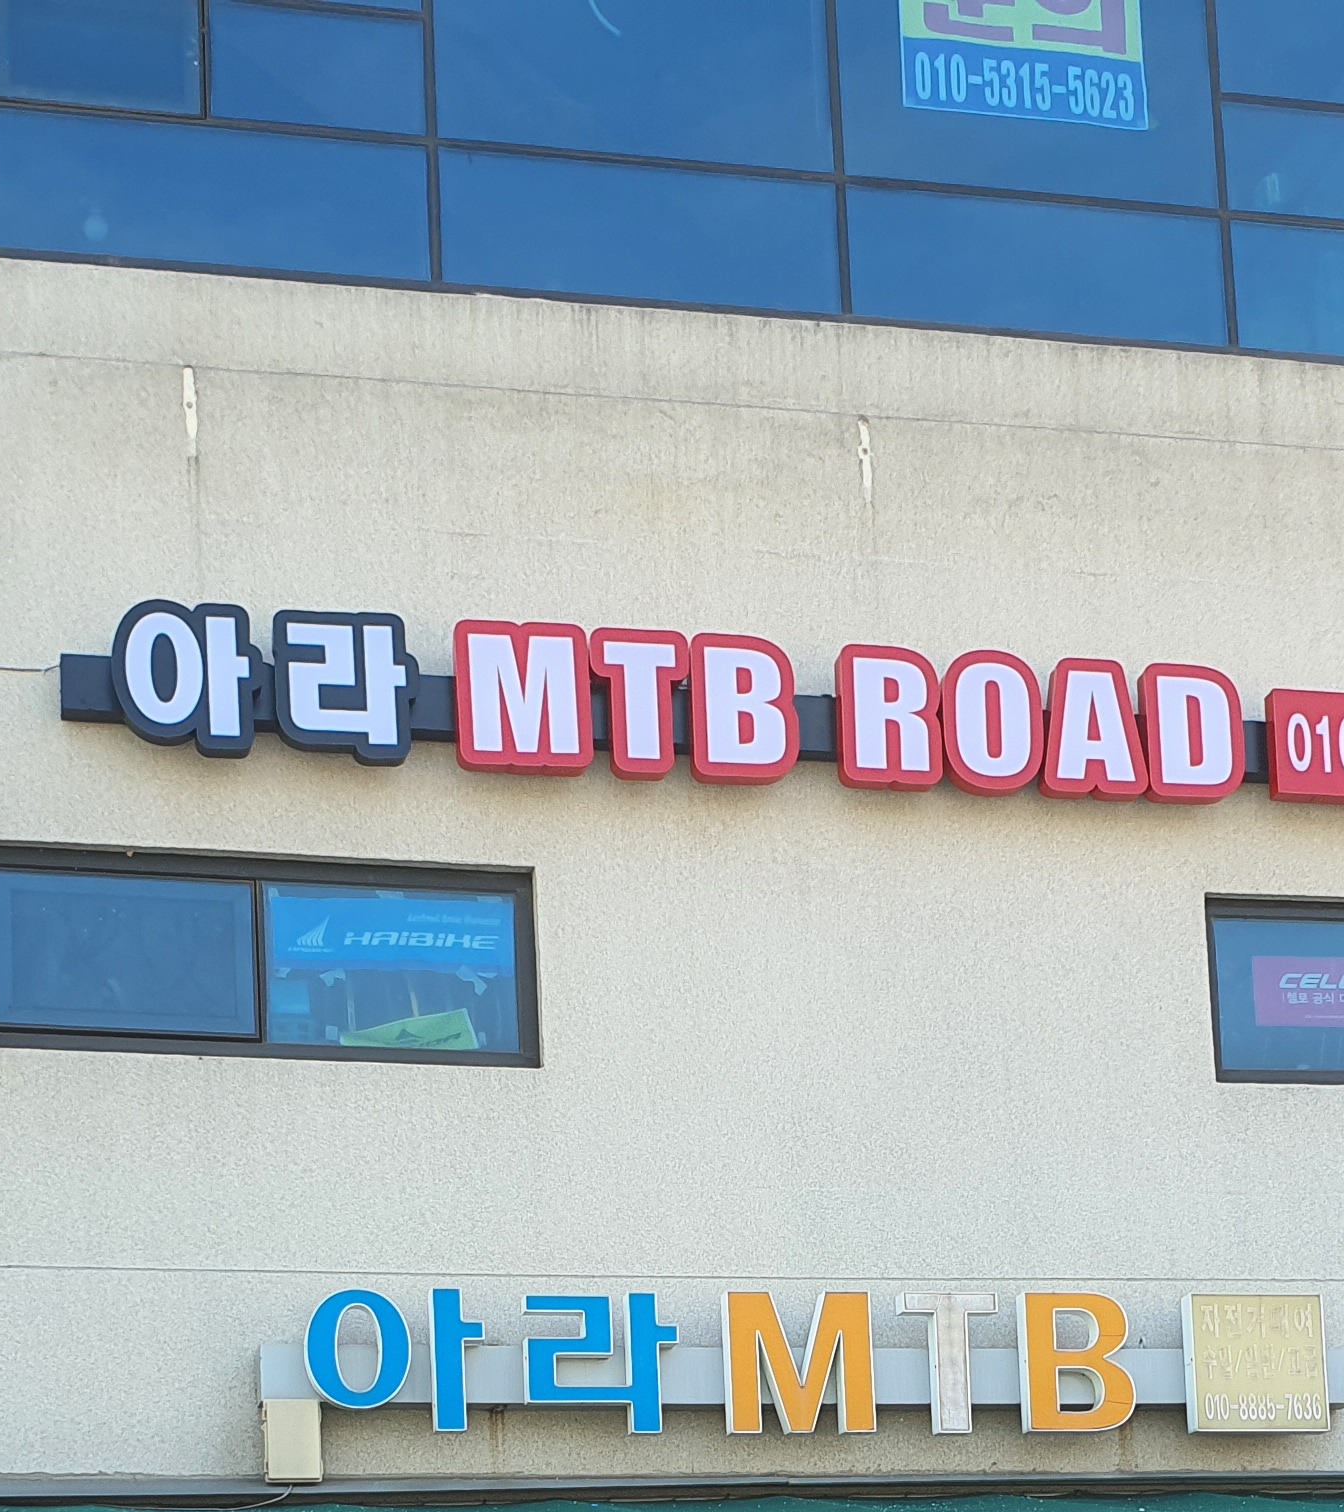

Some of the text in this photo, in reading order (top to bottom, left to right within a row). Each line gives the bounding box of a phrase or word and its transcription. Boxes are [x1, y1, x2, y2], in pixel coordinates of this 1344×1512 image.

[914, 50, 1136, 121] 010-5315-5623
[122, 610, 1235, 787] 아라 MTB ROAD
[1313, 992, 1335, 1005] 공식
[303, 1287, 1137, 1435] 아라 MTB
[1205, 1392, 1322, 1421] 010-8885-7636
